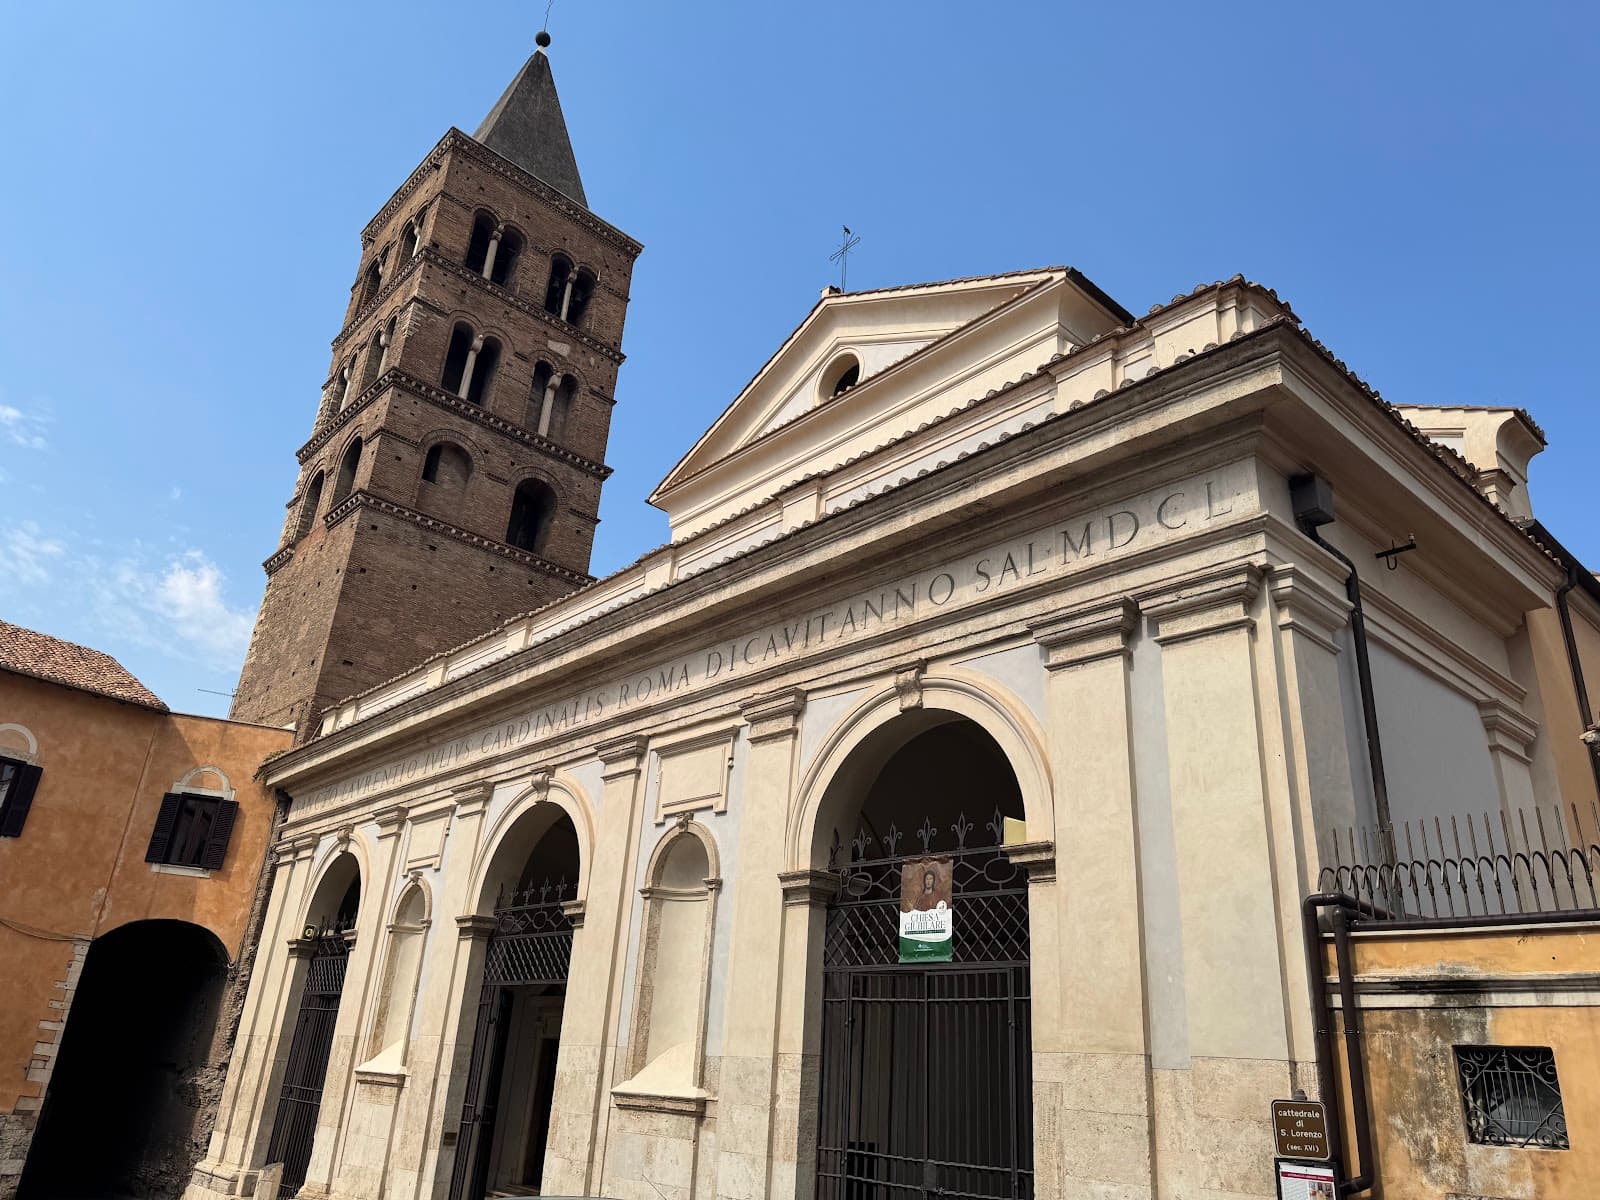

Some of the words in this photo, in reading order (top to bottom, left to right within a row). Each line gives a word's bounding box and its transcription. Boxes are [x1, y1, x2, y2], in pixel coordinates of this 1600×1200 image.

[481, 692, 606, 754] CARDINALIS
[618, 663, 690, 709] ROMA
[705, 612, 834, 679] DICAVIT
[838, 573, 955, 639] ANNO
[910, 913, 939, 922] CHIESA
[1278, 1110, 1320, 1118] cattedrale
[1295, 1120, 1304, 1128] di
[1280, 1129, 1289, 1137] S.
[1291, 1129, 1323, 1138] Lorenzo
